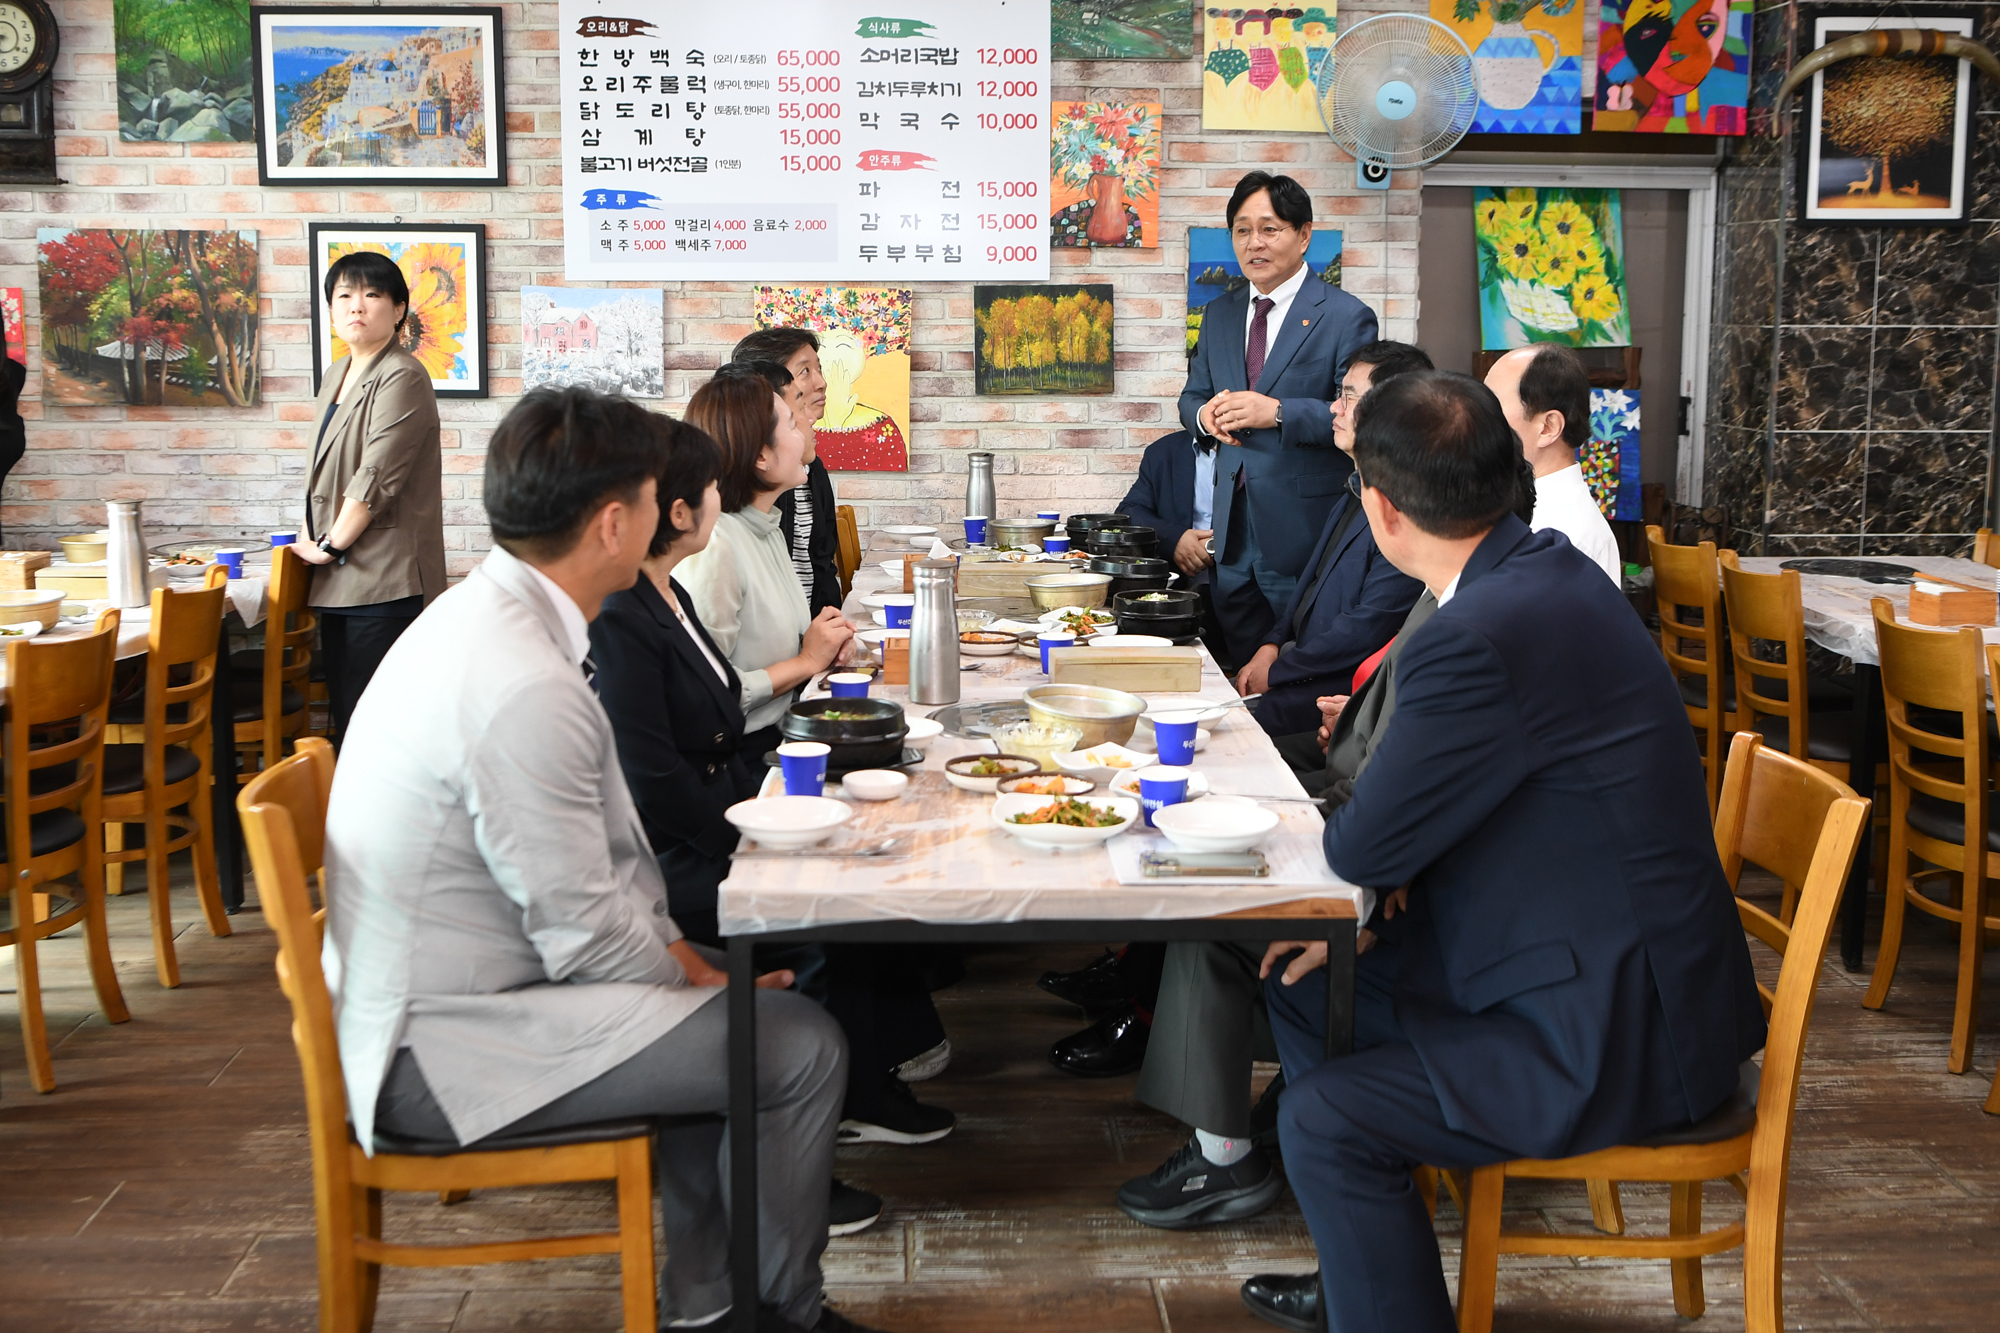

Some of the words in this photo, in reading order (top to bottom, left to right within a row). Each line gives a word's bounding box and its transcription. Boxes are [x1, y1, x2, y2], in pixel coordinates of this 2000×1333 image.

[12, 11, 16, 19] 1
[21, 20, 27, 28] 2
[869, 22, 900, 34] 식사류
[24, 34, 31, 42] 3
[21, 46, 28, 54] 4
[860, 48, 959, 65] 소머리국밥
[977, 48, 1037, 67] 12,000
[0, 58, 7, 67] 6
[13, 56, 19, 65] 5
[778, 50, 840, 69] 65,000
[778, 77, 840, 95] 55,000
[857, 82, 961, 98] 김치두루치기
[977, 81, 1037, 99] 12,000
[779, 103, 840, 121] 55,000
[977, 114, 1037, 132] 10,000
[780, 129, 840, 148] 15,000
[581, 156, 631, 173] 불고기
[638, 156, 707, 172] 버섯전골
[715, 160, 741, 169] (1인분)
[780, 155, 841, 174] 15,000
[869, 155, 901, 166] 안주류
[977, 182, 1037, 200] 15,000
[634, 220, 665, 232] 5,000
[675, 219, 710, 231] 막걸리
[714, 220, 746, 232] 4,000
[753, 219, 789, 231] 음료수
[795, 220, 826, 231] 2,000
[978, 214, 1037, 232] 15,000
[635, 240, 666, 251] 5,000
[675, 239, 711, 251] 백세주
[715, 240, 746, 251] 7,000
[987, 246, 1037, 264] 9,000
